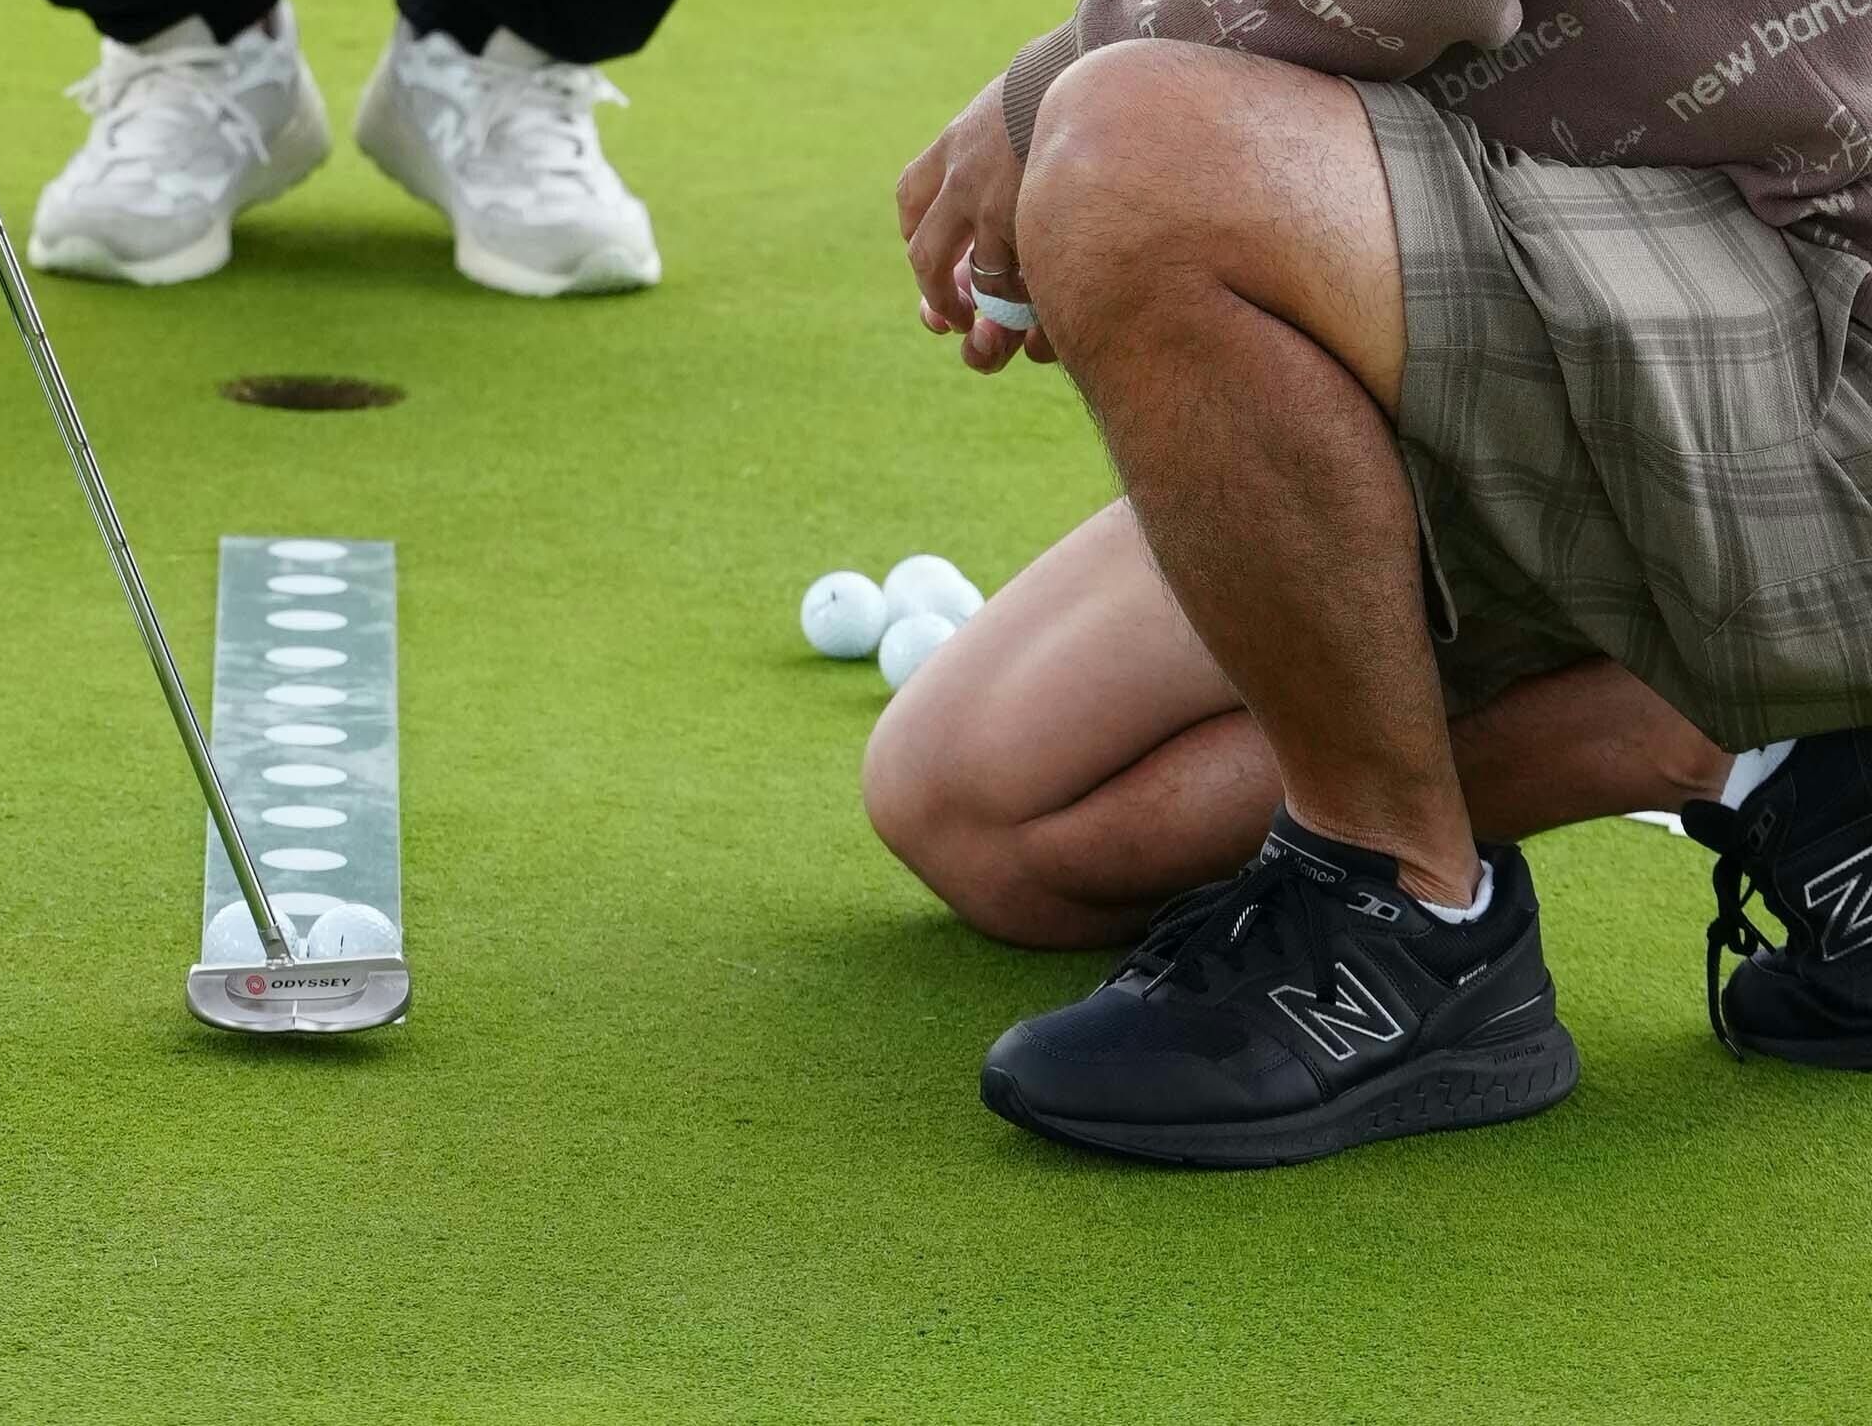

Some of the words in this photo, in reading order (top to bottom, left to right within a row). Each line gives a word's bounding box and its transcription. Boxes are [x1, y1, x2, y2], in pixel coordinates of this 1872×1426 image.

[1430, 10, 1585, 108] balance
[1665, 40, 1757, 122] new
[271, 977, 352, 990] ODYSSEY
